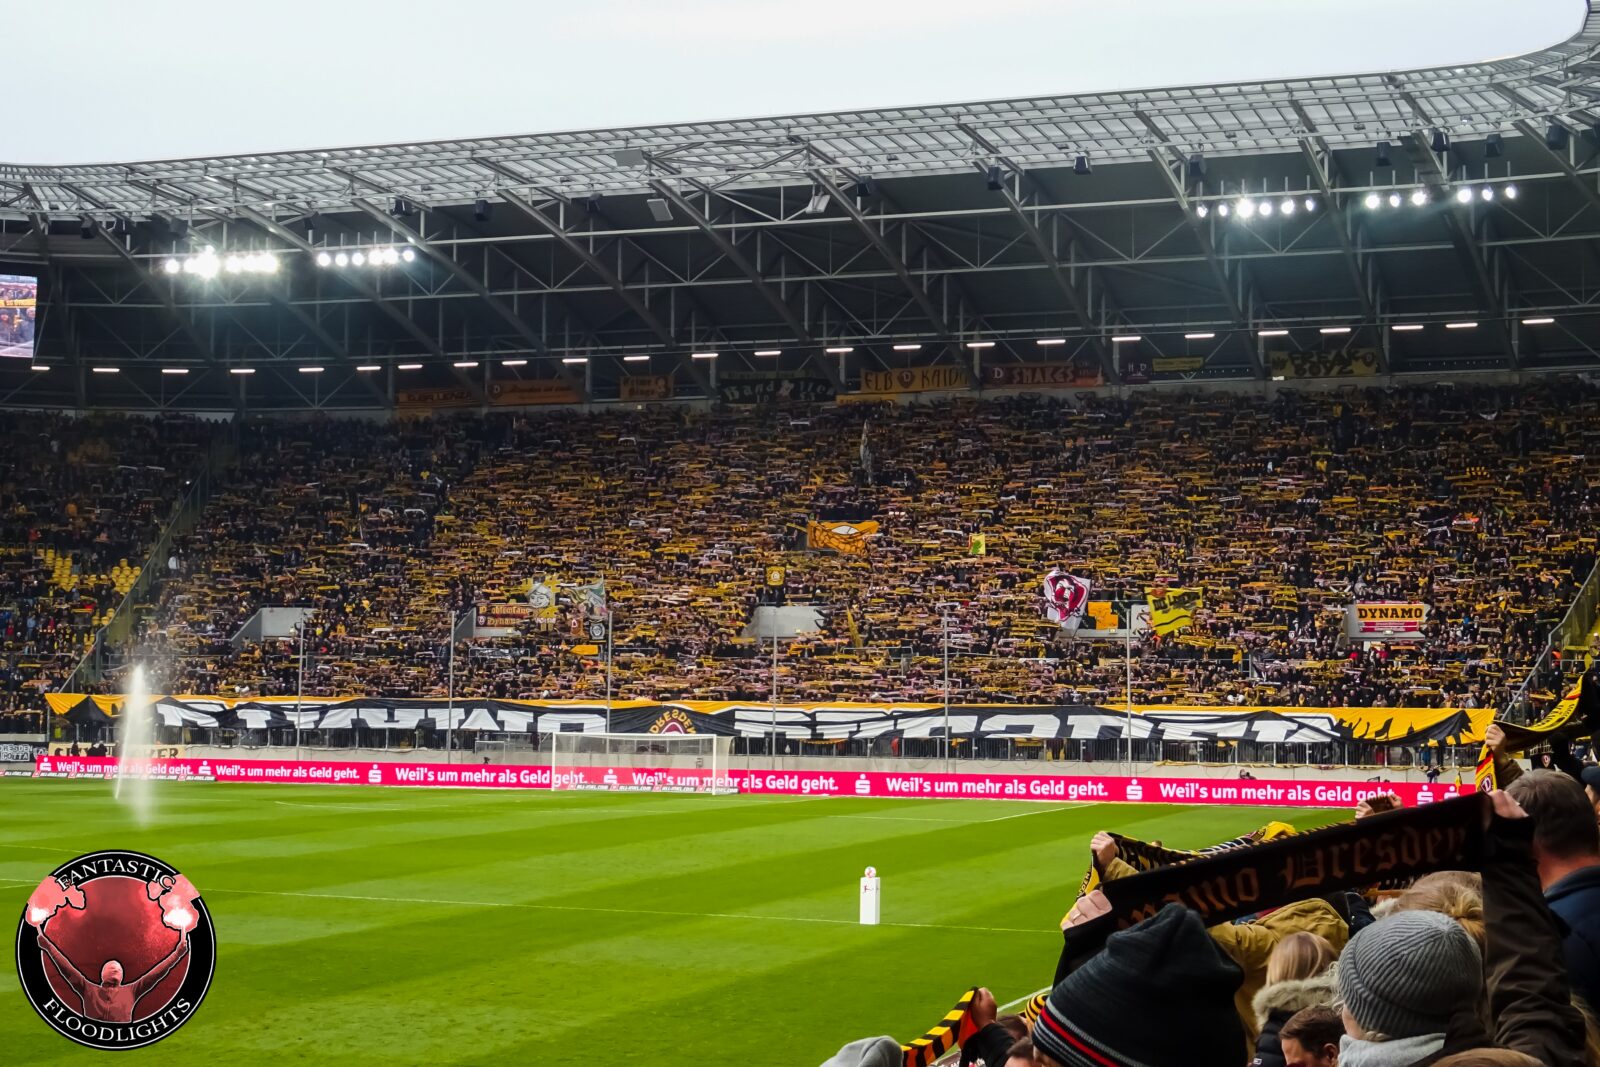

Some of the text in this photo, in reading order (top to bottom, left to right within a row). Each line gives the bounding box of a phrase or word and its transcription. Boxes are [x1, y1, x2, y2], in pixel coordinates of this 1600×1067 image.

[1358, 608, 1423, 618] DYNAMO
[57, 762, 84, 773] Weil's
[86, 765, 101, 773] um
[146, 762, 167, 774] Geld
[215, 765, 360, 781] Weil's um mehr als Geld geht.
[395, 767, 587, 785] Weil's um mehr als Geld geht.
[632, 772, 838, 792] Weil's um mehr als Geld geht.
[886, 777, 1108, 798] Weil's um mehr als Geld geht.
[1159, 783, 1208, 797] Weil's
[1212, 787, 1236, 798] um
[1241, 784, 1284, 800] mehr
[1287, 785, 1310, 800] als
[1314, 786, 1352, 801] Geld
